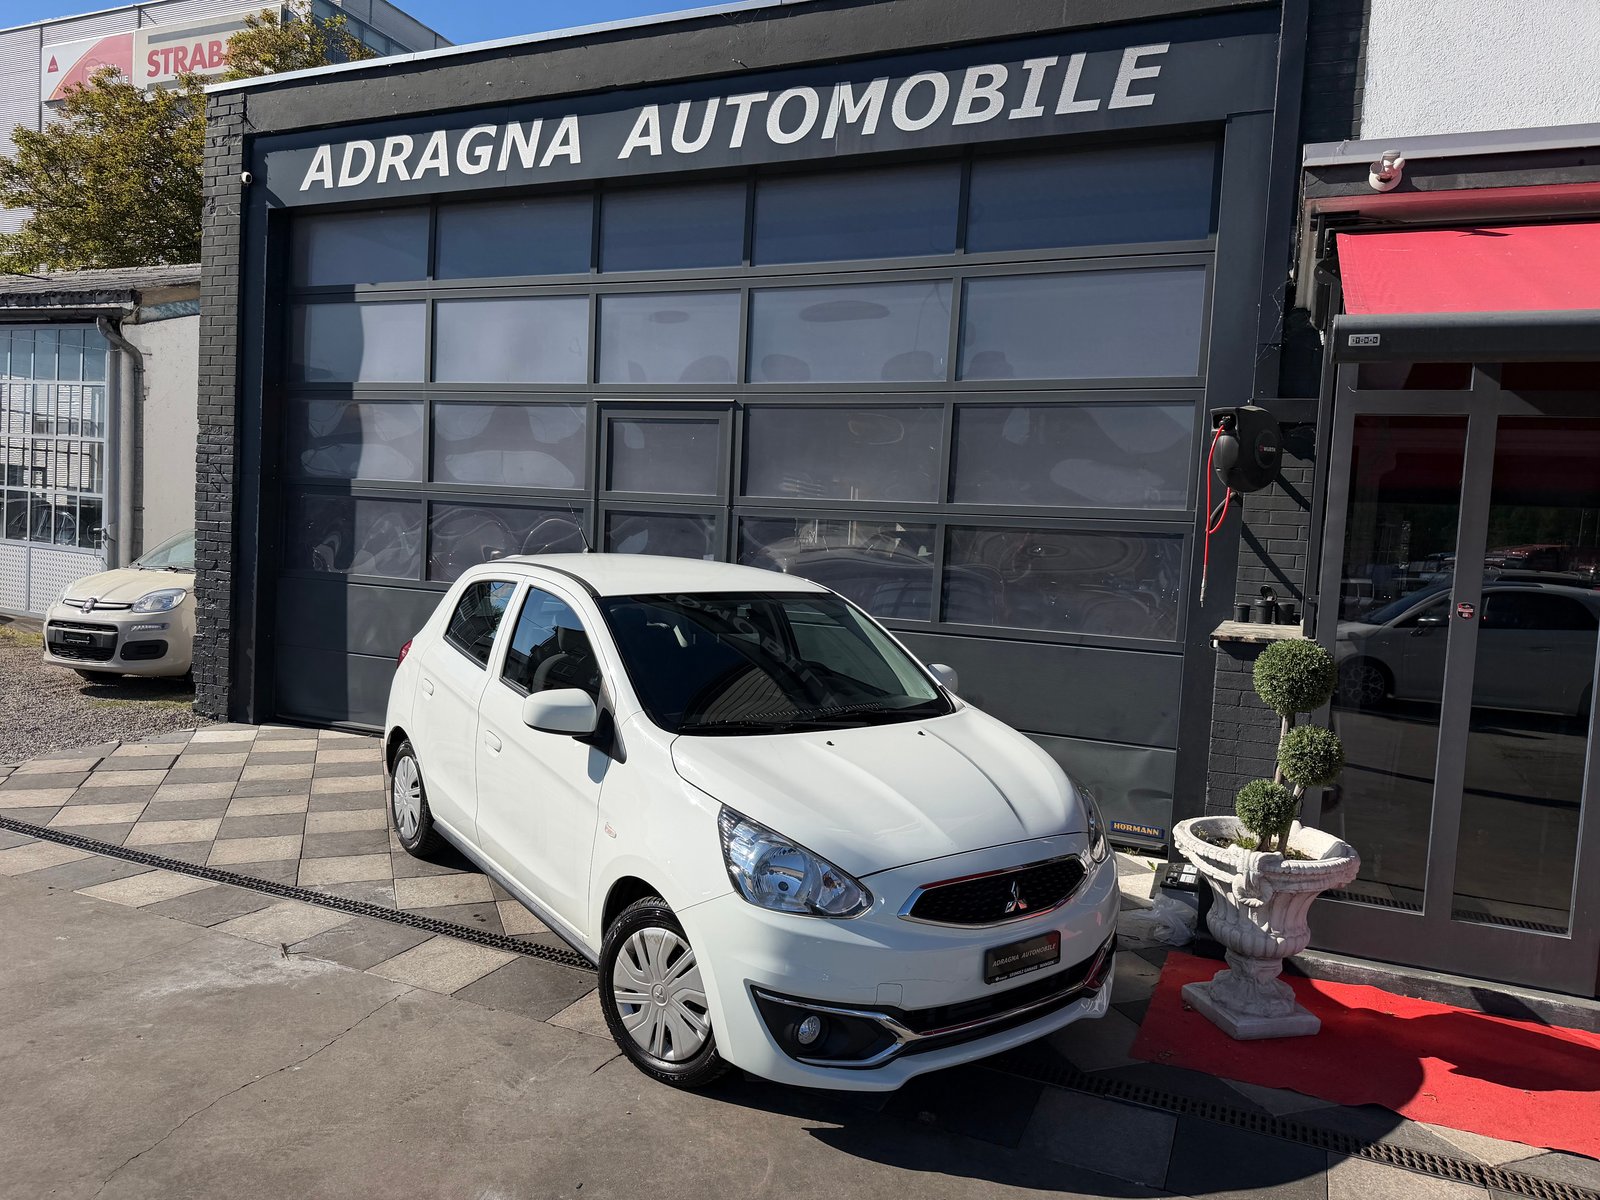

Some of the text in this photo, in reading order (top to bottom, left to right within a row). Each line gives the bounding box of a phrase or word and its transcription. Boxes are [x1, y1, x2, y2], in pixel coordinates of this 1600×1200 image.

[147, 40, 228, 77] STRAB
[300, 42, 1170, 191] ADRAGNA AUTOMOBILE
[992, 943, 1056, 967] ADRAGNA AUTOMOBILE
